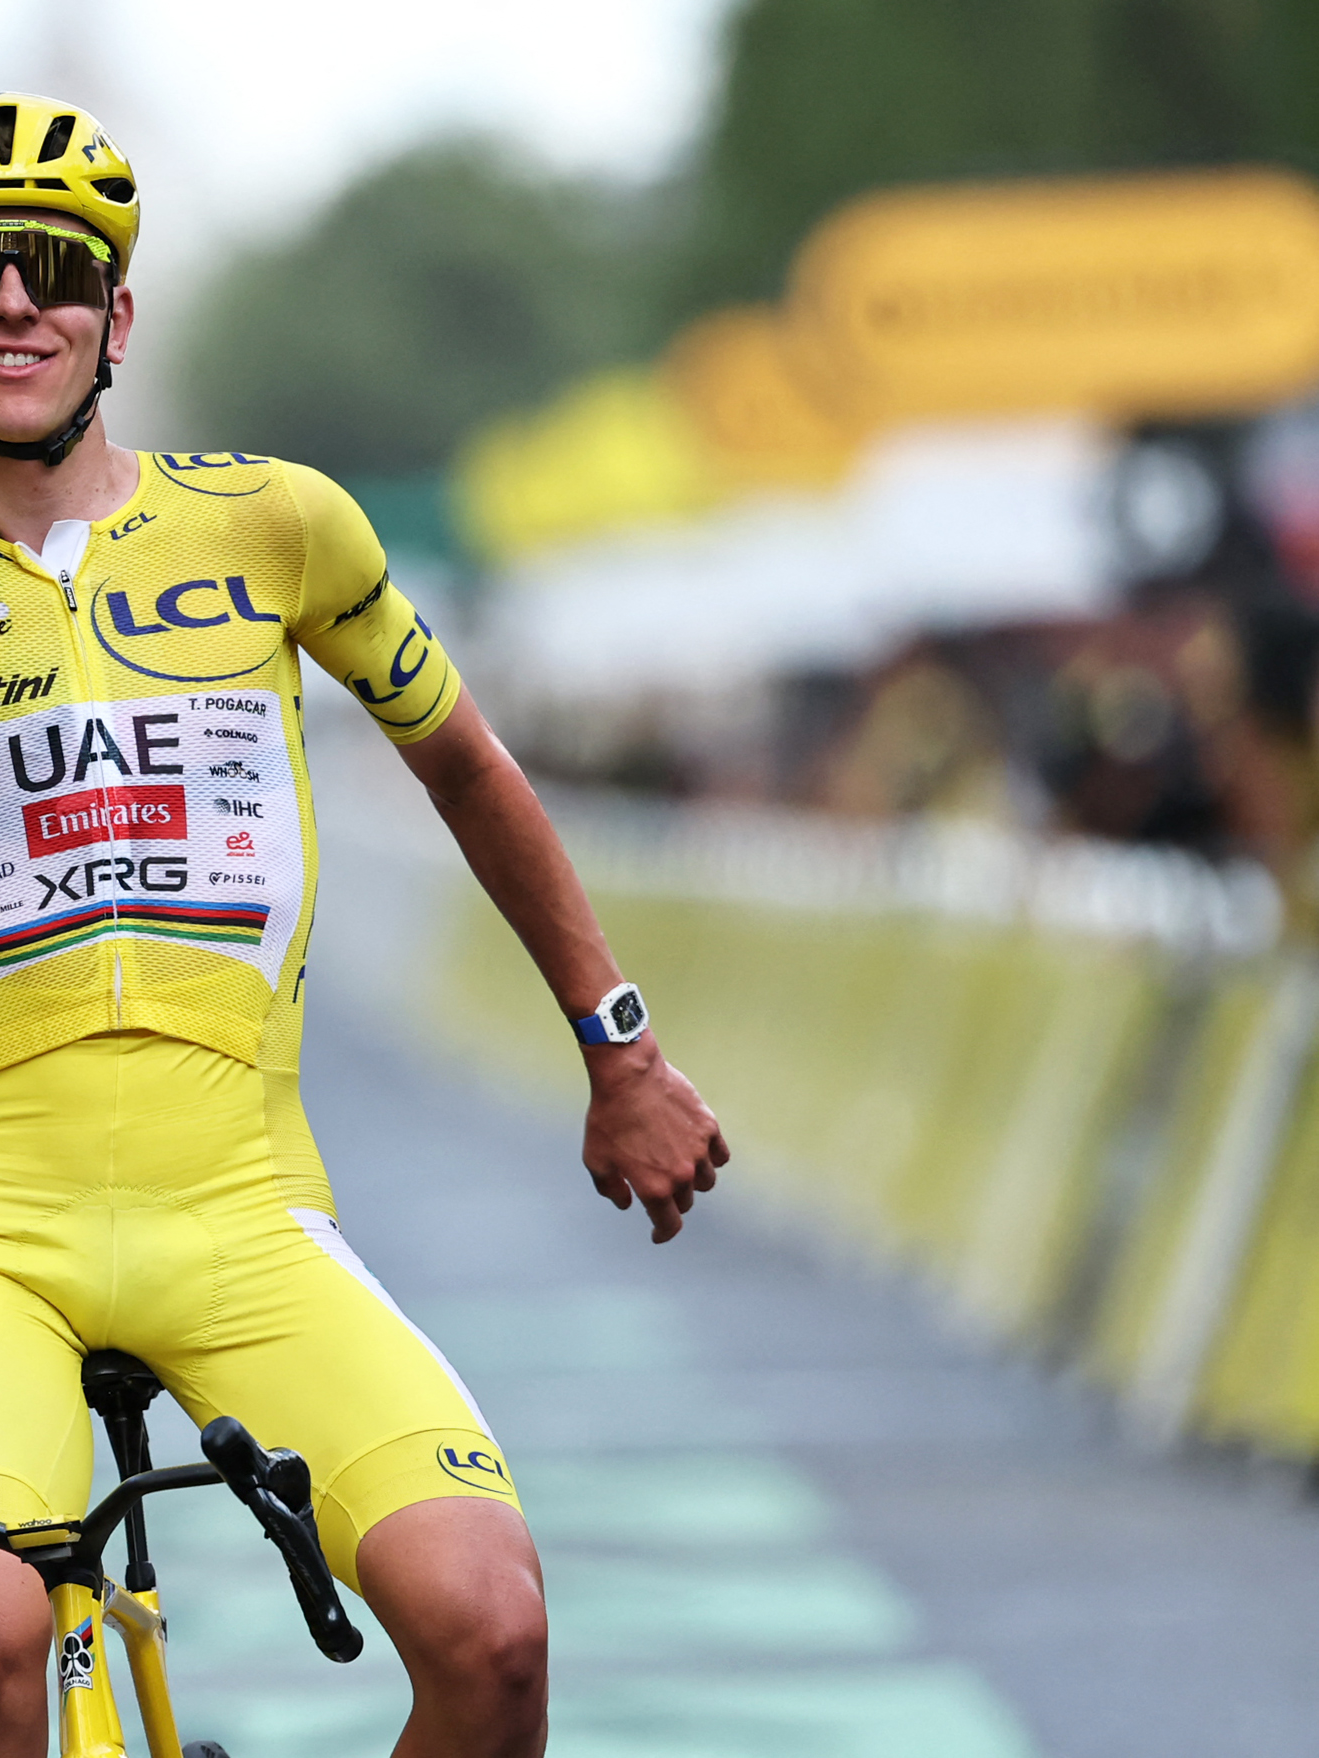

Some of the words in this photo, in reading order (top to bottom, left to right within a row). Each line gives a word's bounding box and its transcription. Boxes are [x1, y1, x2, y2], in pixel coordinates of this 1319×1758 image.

[160, 452, 270, 471] LCL
[110, 512, 157, 540] LCL
[106, 576, 280, 637] LCL
[189, 698, 201, 710] T.
[205, 697, 266, 717] POGACAR
[215, 729, 258, 743] COLNAGO
[8, 713, 184, 793] UAE
[233, 800, 264, 818] IHC
[39, 801, 172, 840] Emirates
[34, 857, 188, 910] XRG
[223, 874, 266, 886] PISSEI
[0, 900, 24, 912] MILLE
[18, 1518, 52, 1528] wahoo
